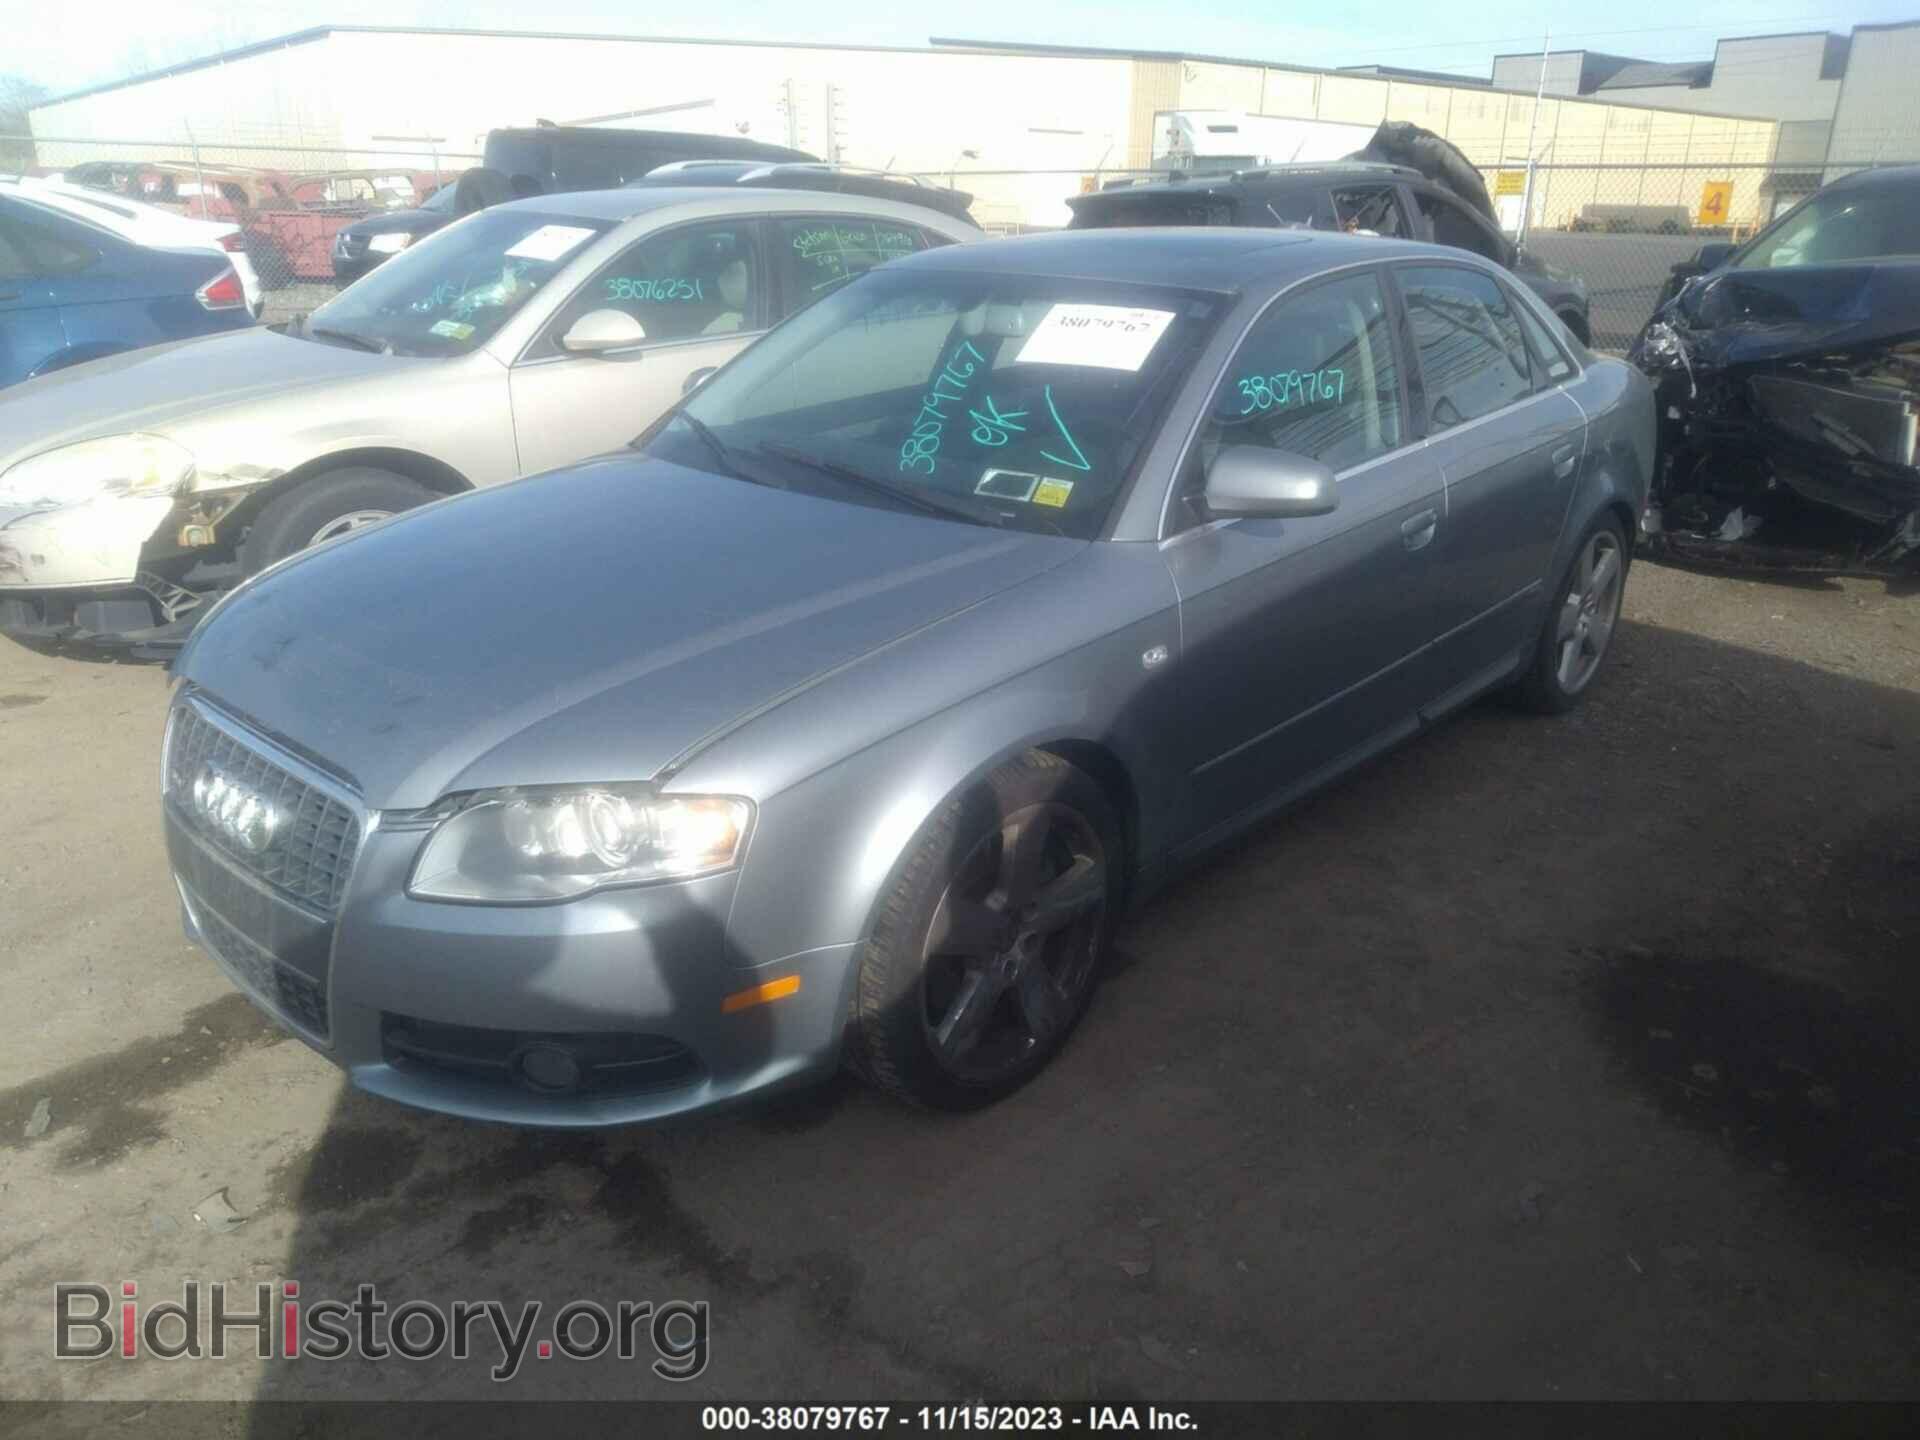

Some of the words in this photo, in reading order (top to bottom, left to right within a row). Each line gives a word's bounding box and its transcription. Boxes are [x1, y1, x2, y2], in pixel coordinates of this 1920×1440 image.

[1705, 191, 1723, 216] 4
[607, 277, 703, 301] 38076251
[900, 340, 985, 474] 38079767
[1238, 368, 1345, 414] 38079767
